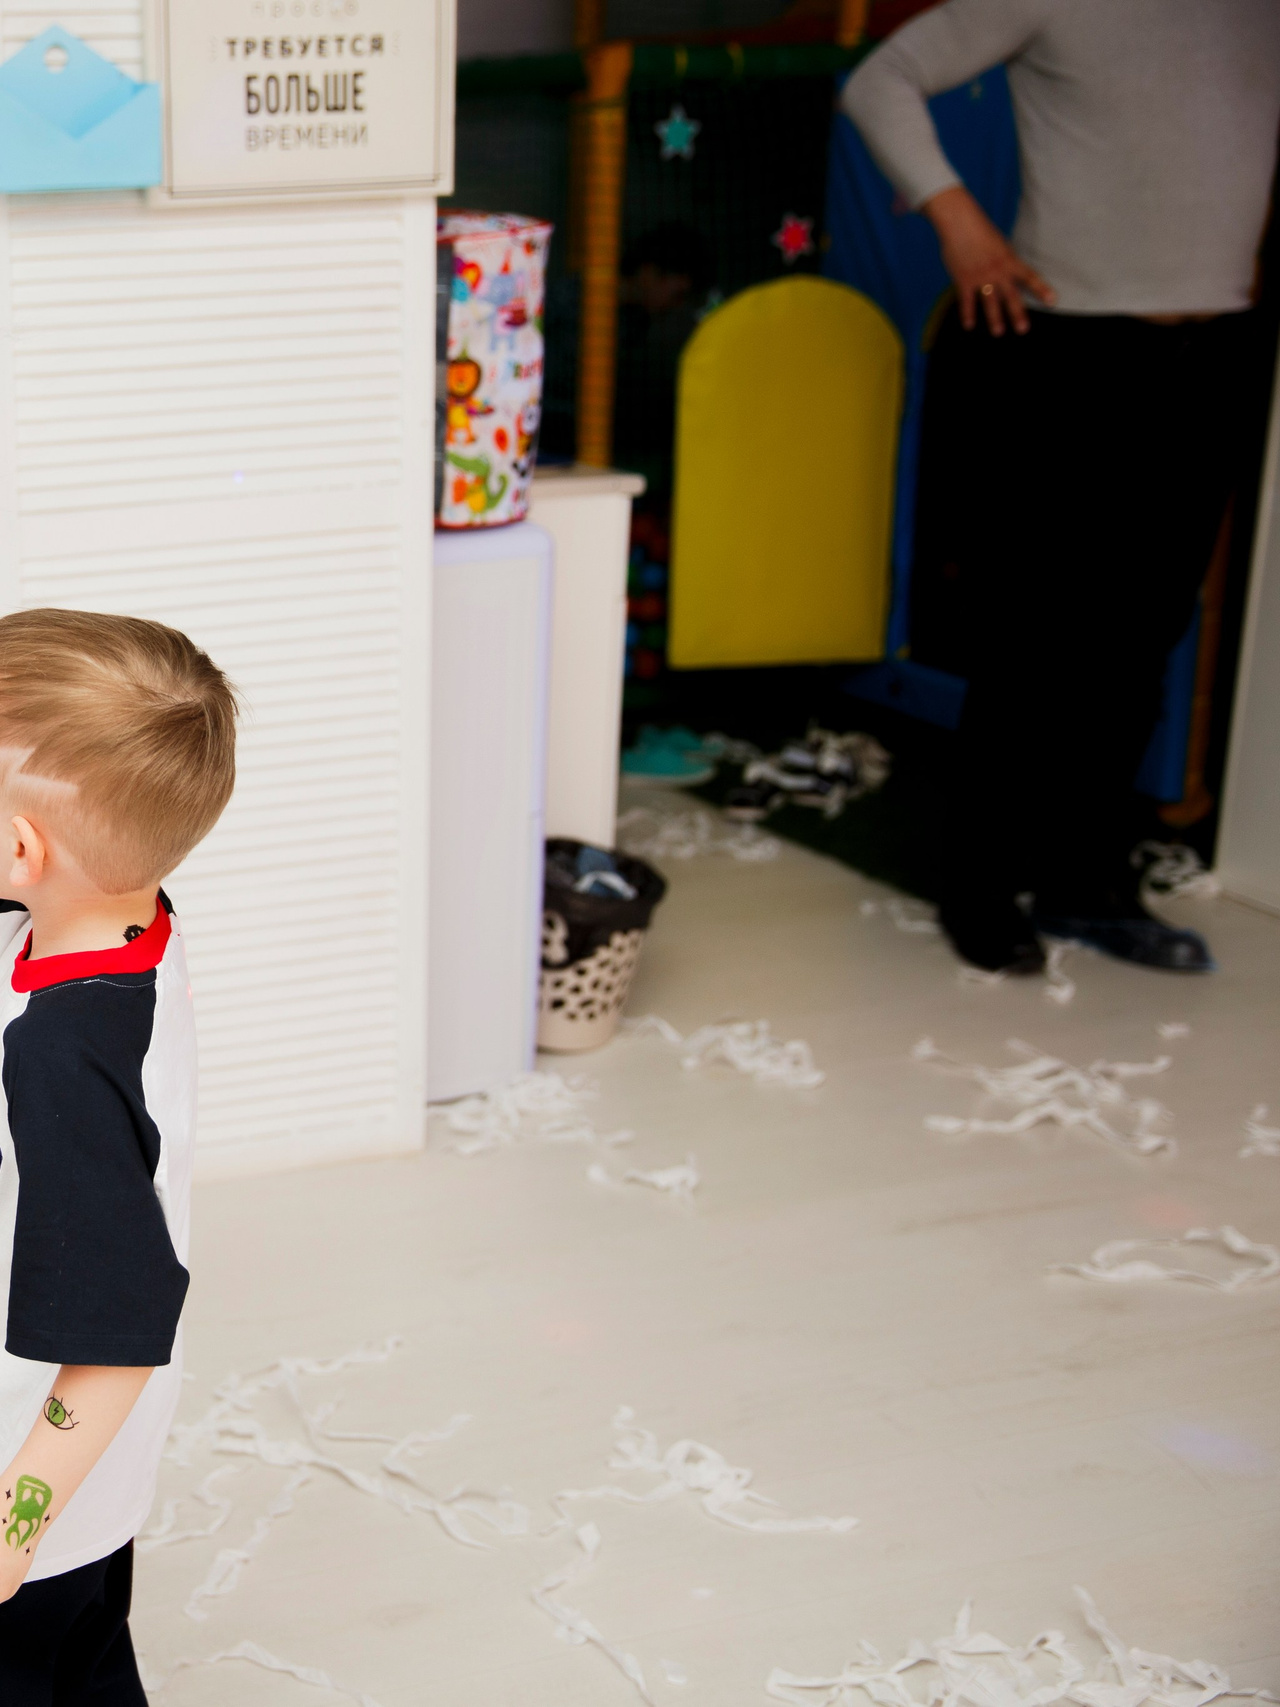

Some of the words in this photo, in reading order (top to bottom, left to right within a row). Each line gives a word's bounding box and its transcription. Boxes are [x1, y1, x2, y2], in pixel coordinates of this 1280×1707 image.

[225, 36, 385, 60] ТРЕБУЕТСЯ
[245, 70, 366, 115] БОЛЬШЕ
[246, 123, 368, 151] ВРЕМЕНИ
